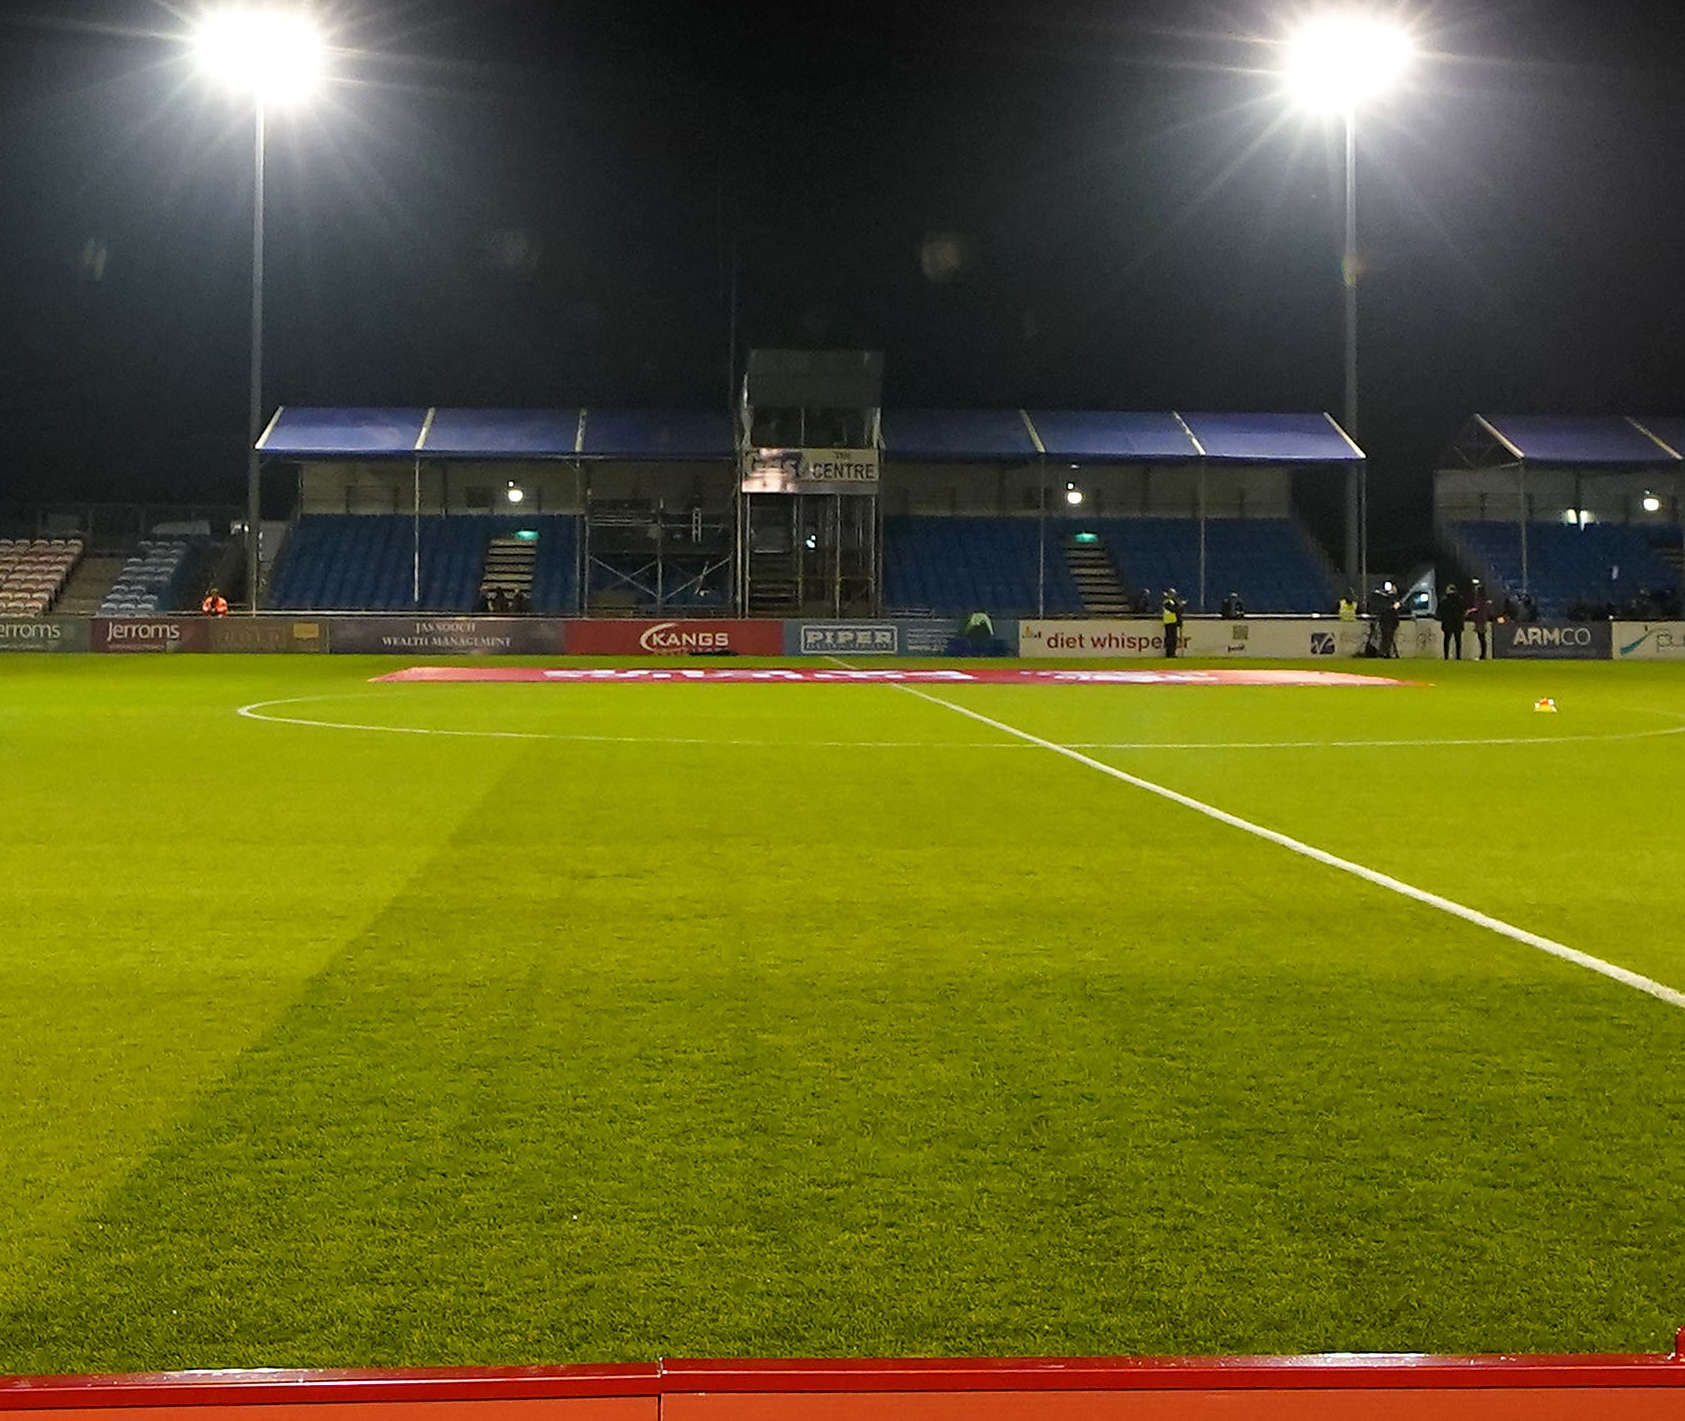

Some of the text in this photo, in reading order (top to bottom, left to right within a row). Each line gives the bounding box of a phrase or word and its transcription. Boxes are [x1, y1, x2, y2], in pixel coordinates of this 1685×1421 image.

[813, 462, 874, 479] CENTRE
[107, 621, 180, 640] Jerroms
[652, 632, 729, 646] KANGS
[805, 631, 893, 644] PIPER
[1513, 627, 1591, 646] ARMCO
[382, 637, 511, 647] WEALTH MANAGEMENT
[1047, 632, 1191, 651] diet whispeer
